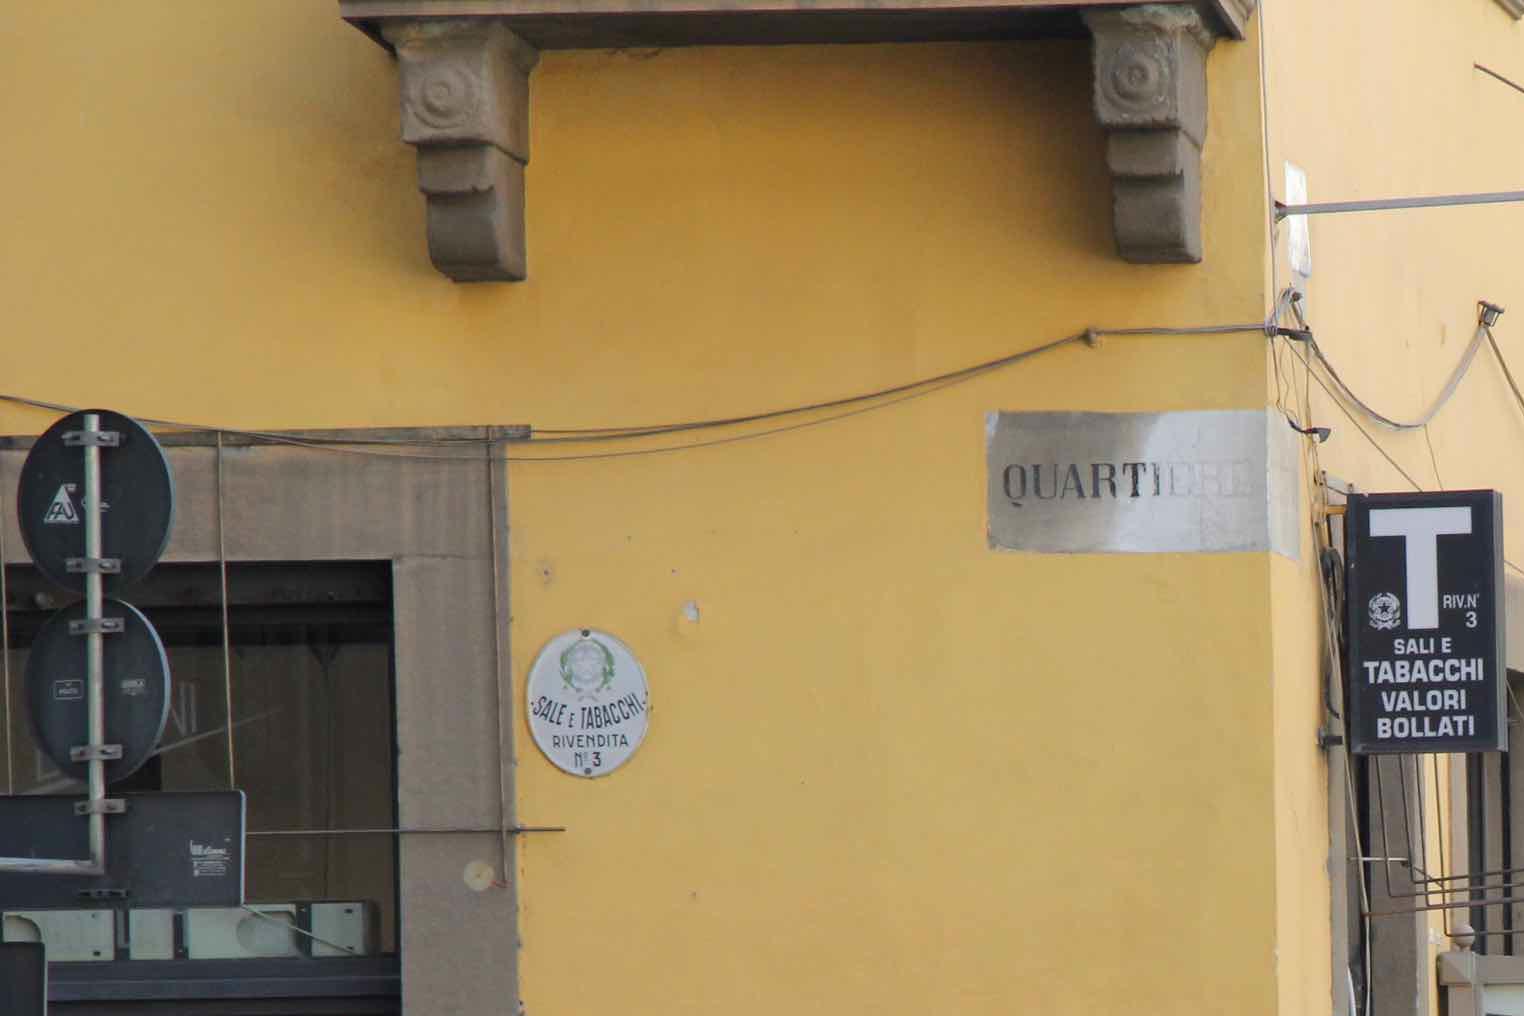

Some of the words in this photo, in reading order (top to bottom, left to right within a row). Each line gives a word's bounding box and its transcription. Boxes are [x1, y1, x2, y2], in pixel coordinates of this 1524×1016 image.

[1369, 507, 1472, 629] T
[1465, 611, 1478, 628] 3
[1393, 637, 1435, 655] SALI
[1441, 637, 1452, 653] E
[1363, 658, 1484, 684] TABACCHI
[532, 695, 567, 726] SALE
[1381, 689, 1467, 712] VALORI
[1376, 715, 1475, 739] BOLLATI
[552, 734, 629, 749] RIVENDITA
[592, 752, 602, 767] 3
